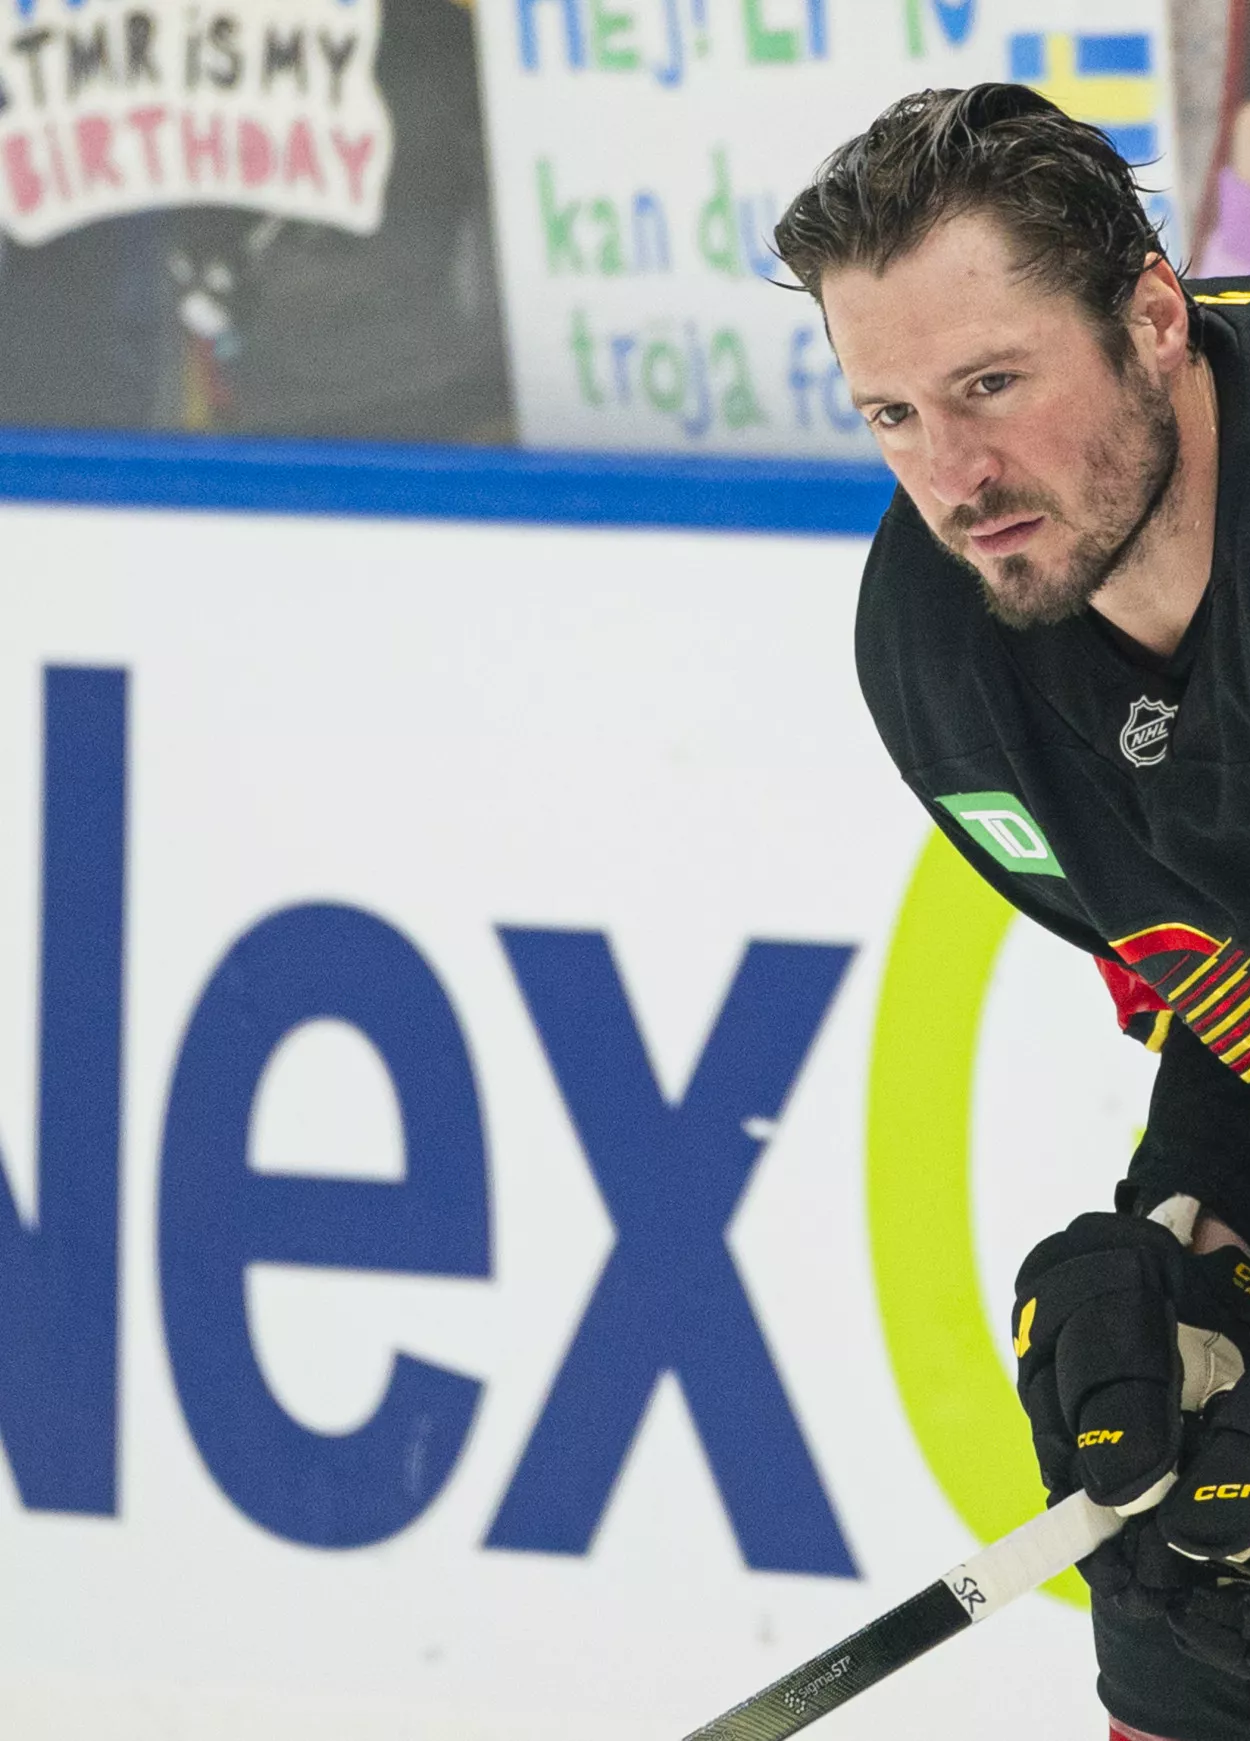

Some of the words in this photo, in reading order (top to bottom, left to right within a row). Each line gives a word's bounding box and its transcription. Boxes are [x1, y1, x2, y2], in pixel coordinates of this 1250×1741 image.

[11, 11, 161, 107] TMR
[262, 24, 360, 104] MY
[535, 154, 673, 277] kan
[696, 142, 780, 281] du
[1131, 720, 1168, 748] NHL
[959, 810, 1048, 859] TD
[1077, 1429, 1125, 1449] CCM
[953, 1576, 986, 1614] SR
